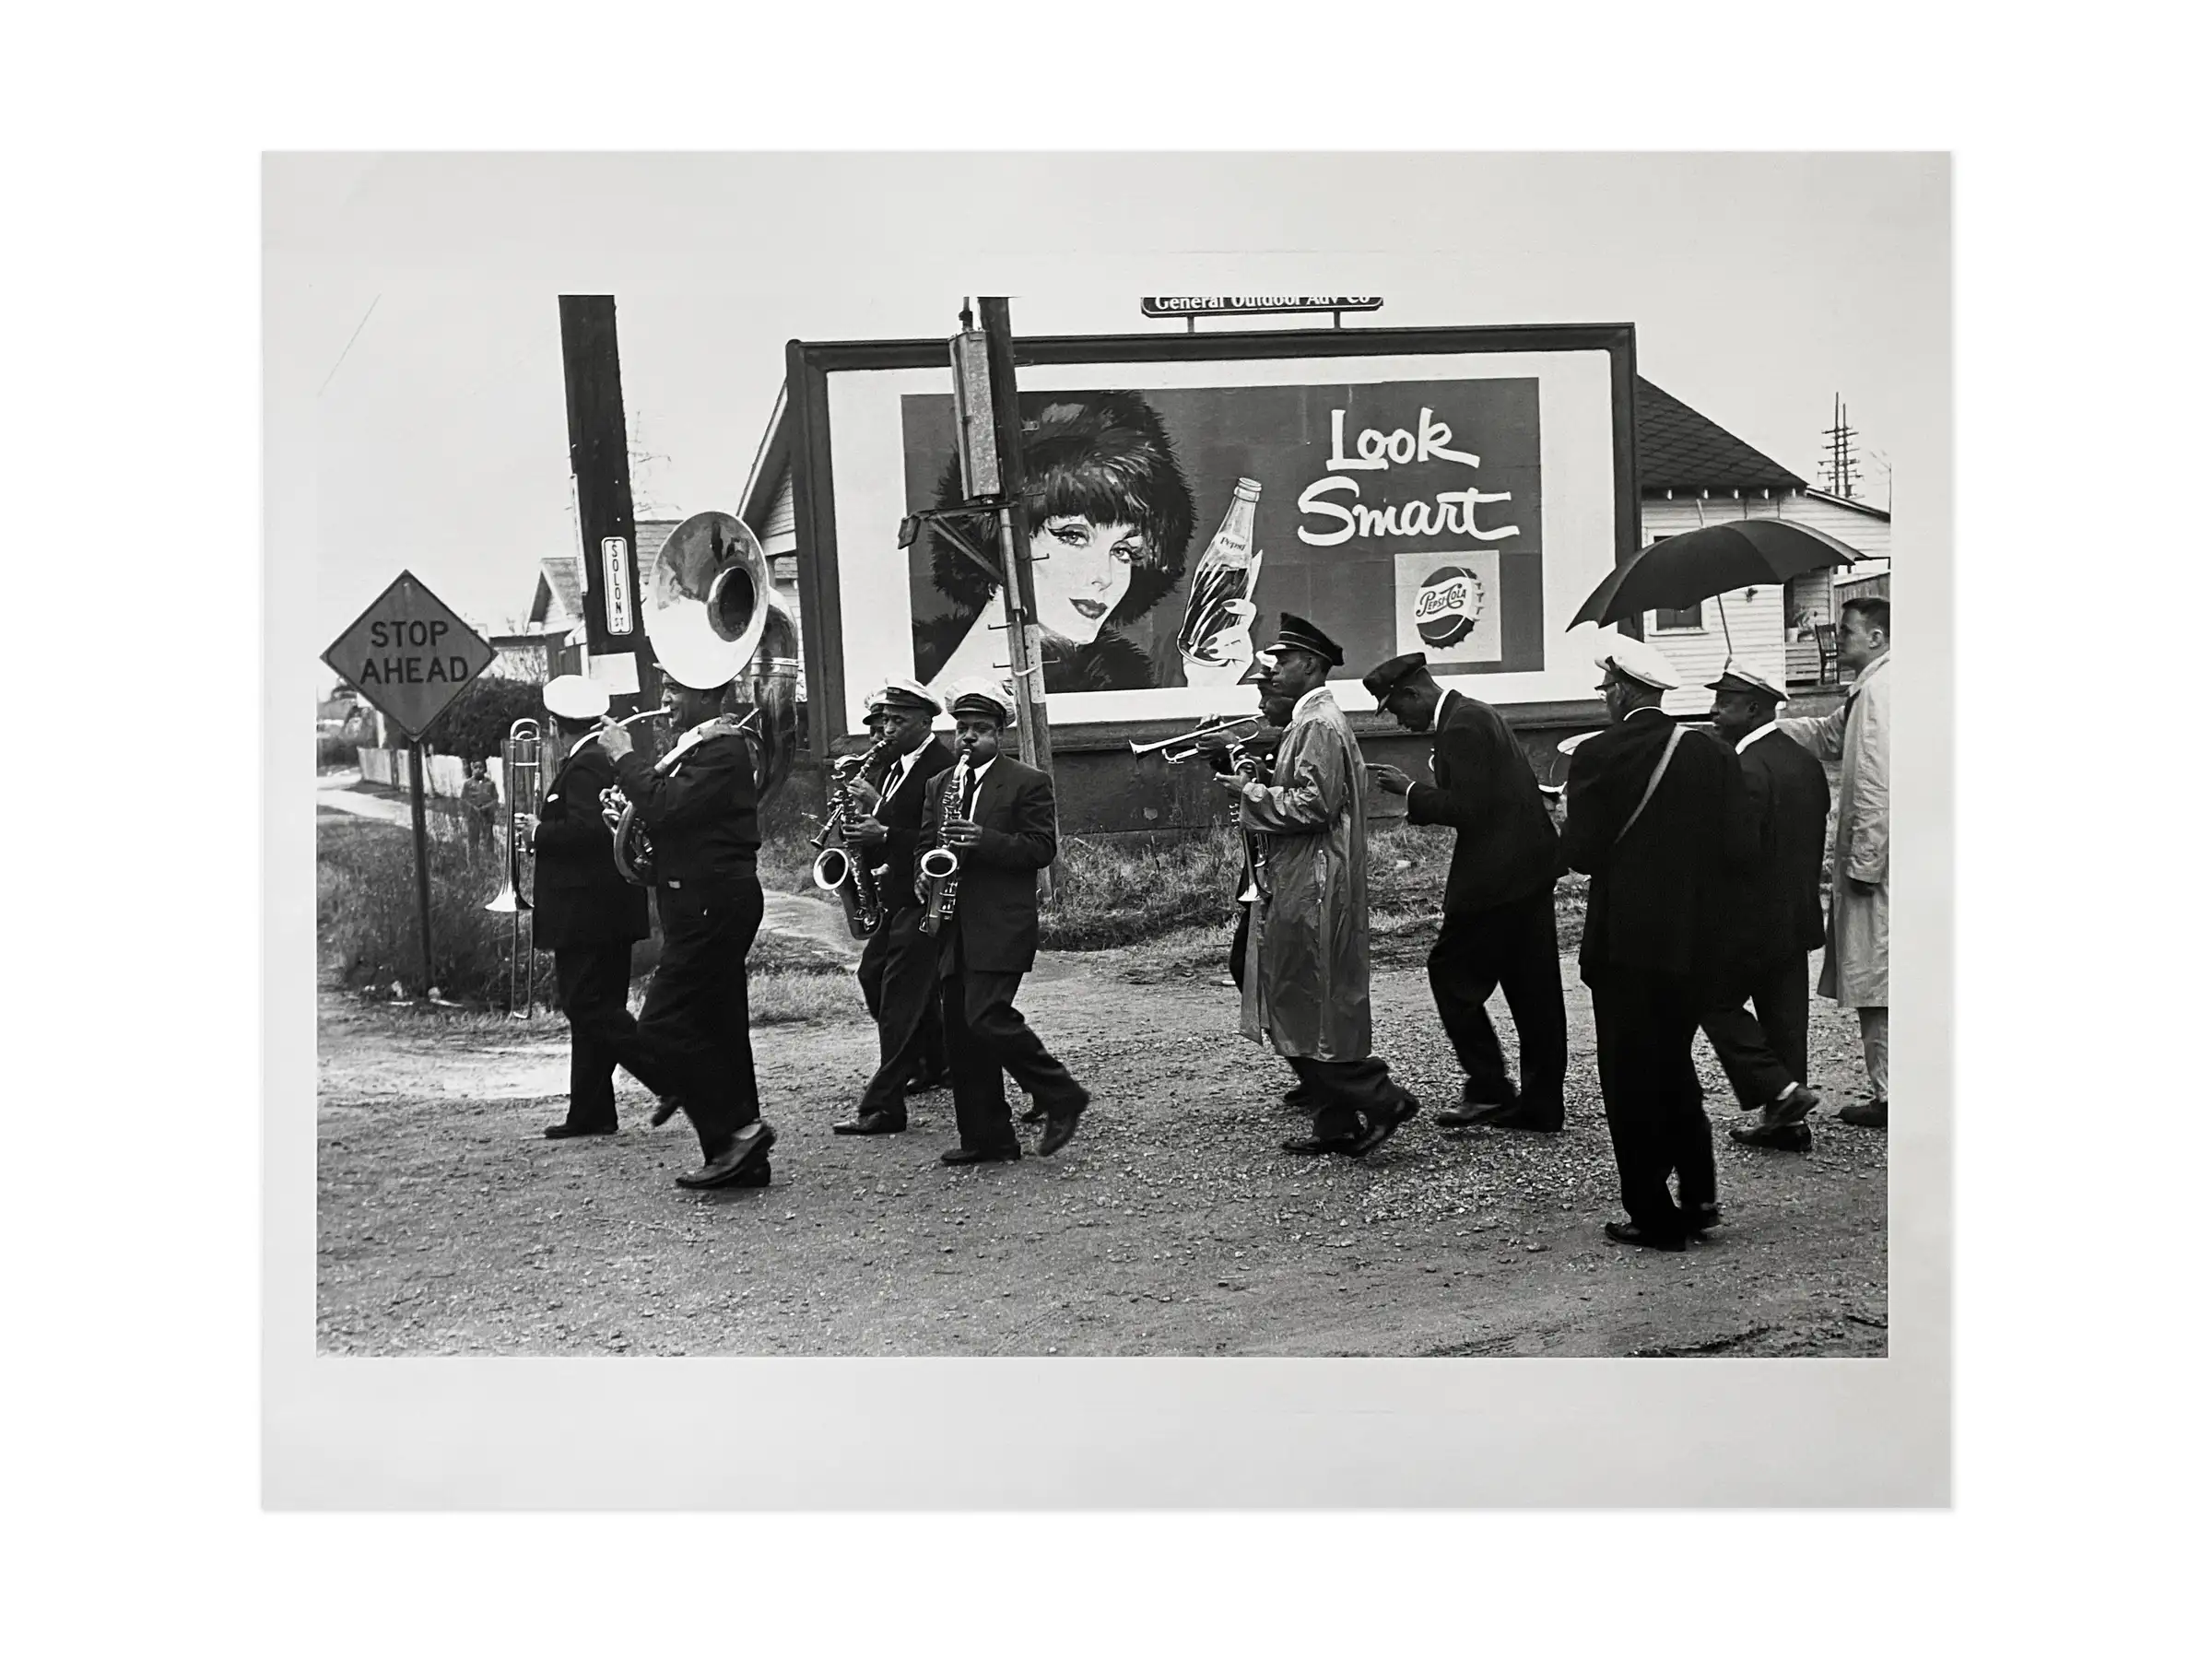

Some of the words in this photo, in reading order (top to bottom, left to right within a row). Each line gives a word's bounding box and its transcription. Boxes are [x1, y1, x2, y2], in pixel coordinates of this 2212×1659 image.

[1155, 296, 1225, 310] General
[1326, 407, 1480, 471] Look
[1298, 476, 1520, 546] Smart
[612, 544, 622, 614] SOLON
[371, 620, 449, 648] STOP
[359, 656, 468, 684] AHEAD
